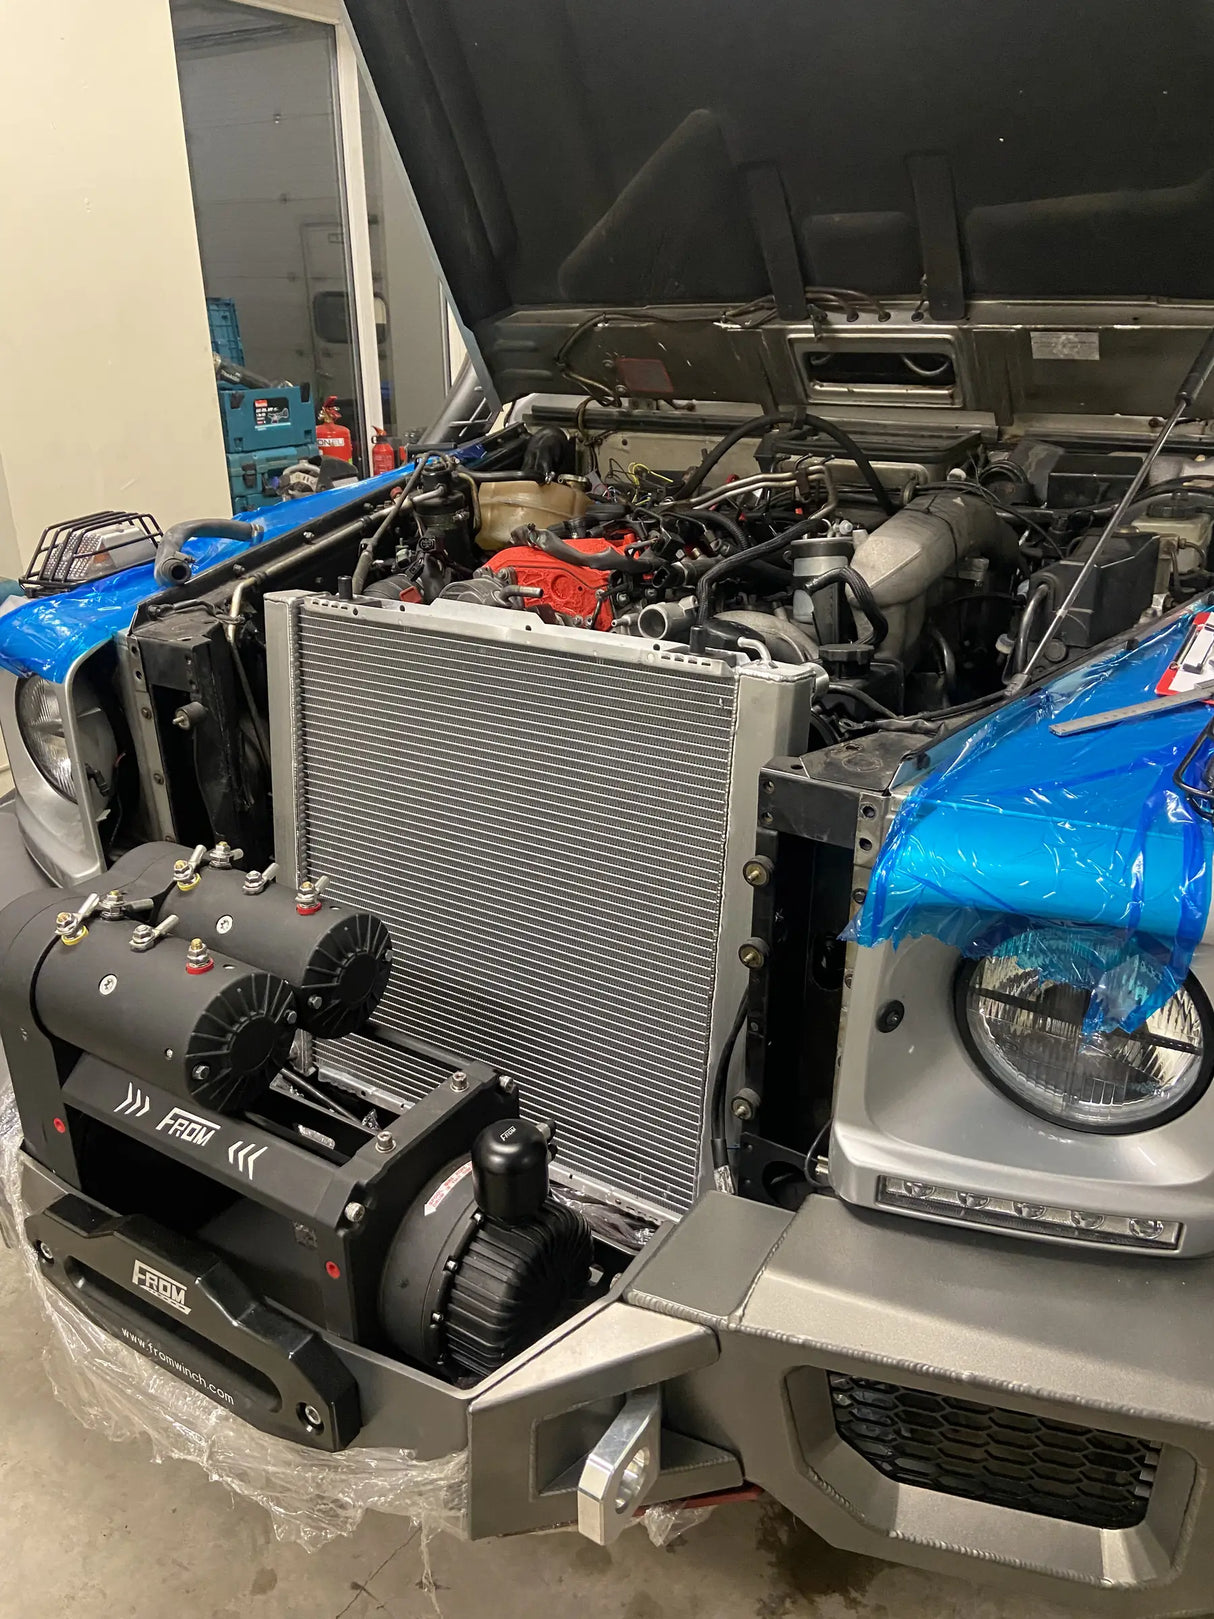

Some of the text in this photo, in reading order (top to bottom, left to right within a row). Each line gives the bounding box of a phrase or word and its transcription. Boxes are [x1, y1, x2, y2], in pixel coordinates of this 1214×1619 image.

[155, 1107, 222, 1147] FROM
[131, 1259, 188, 1305] FROM
[121, 1327, 235, 1406] www.fromwinch.com
